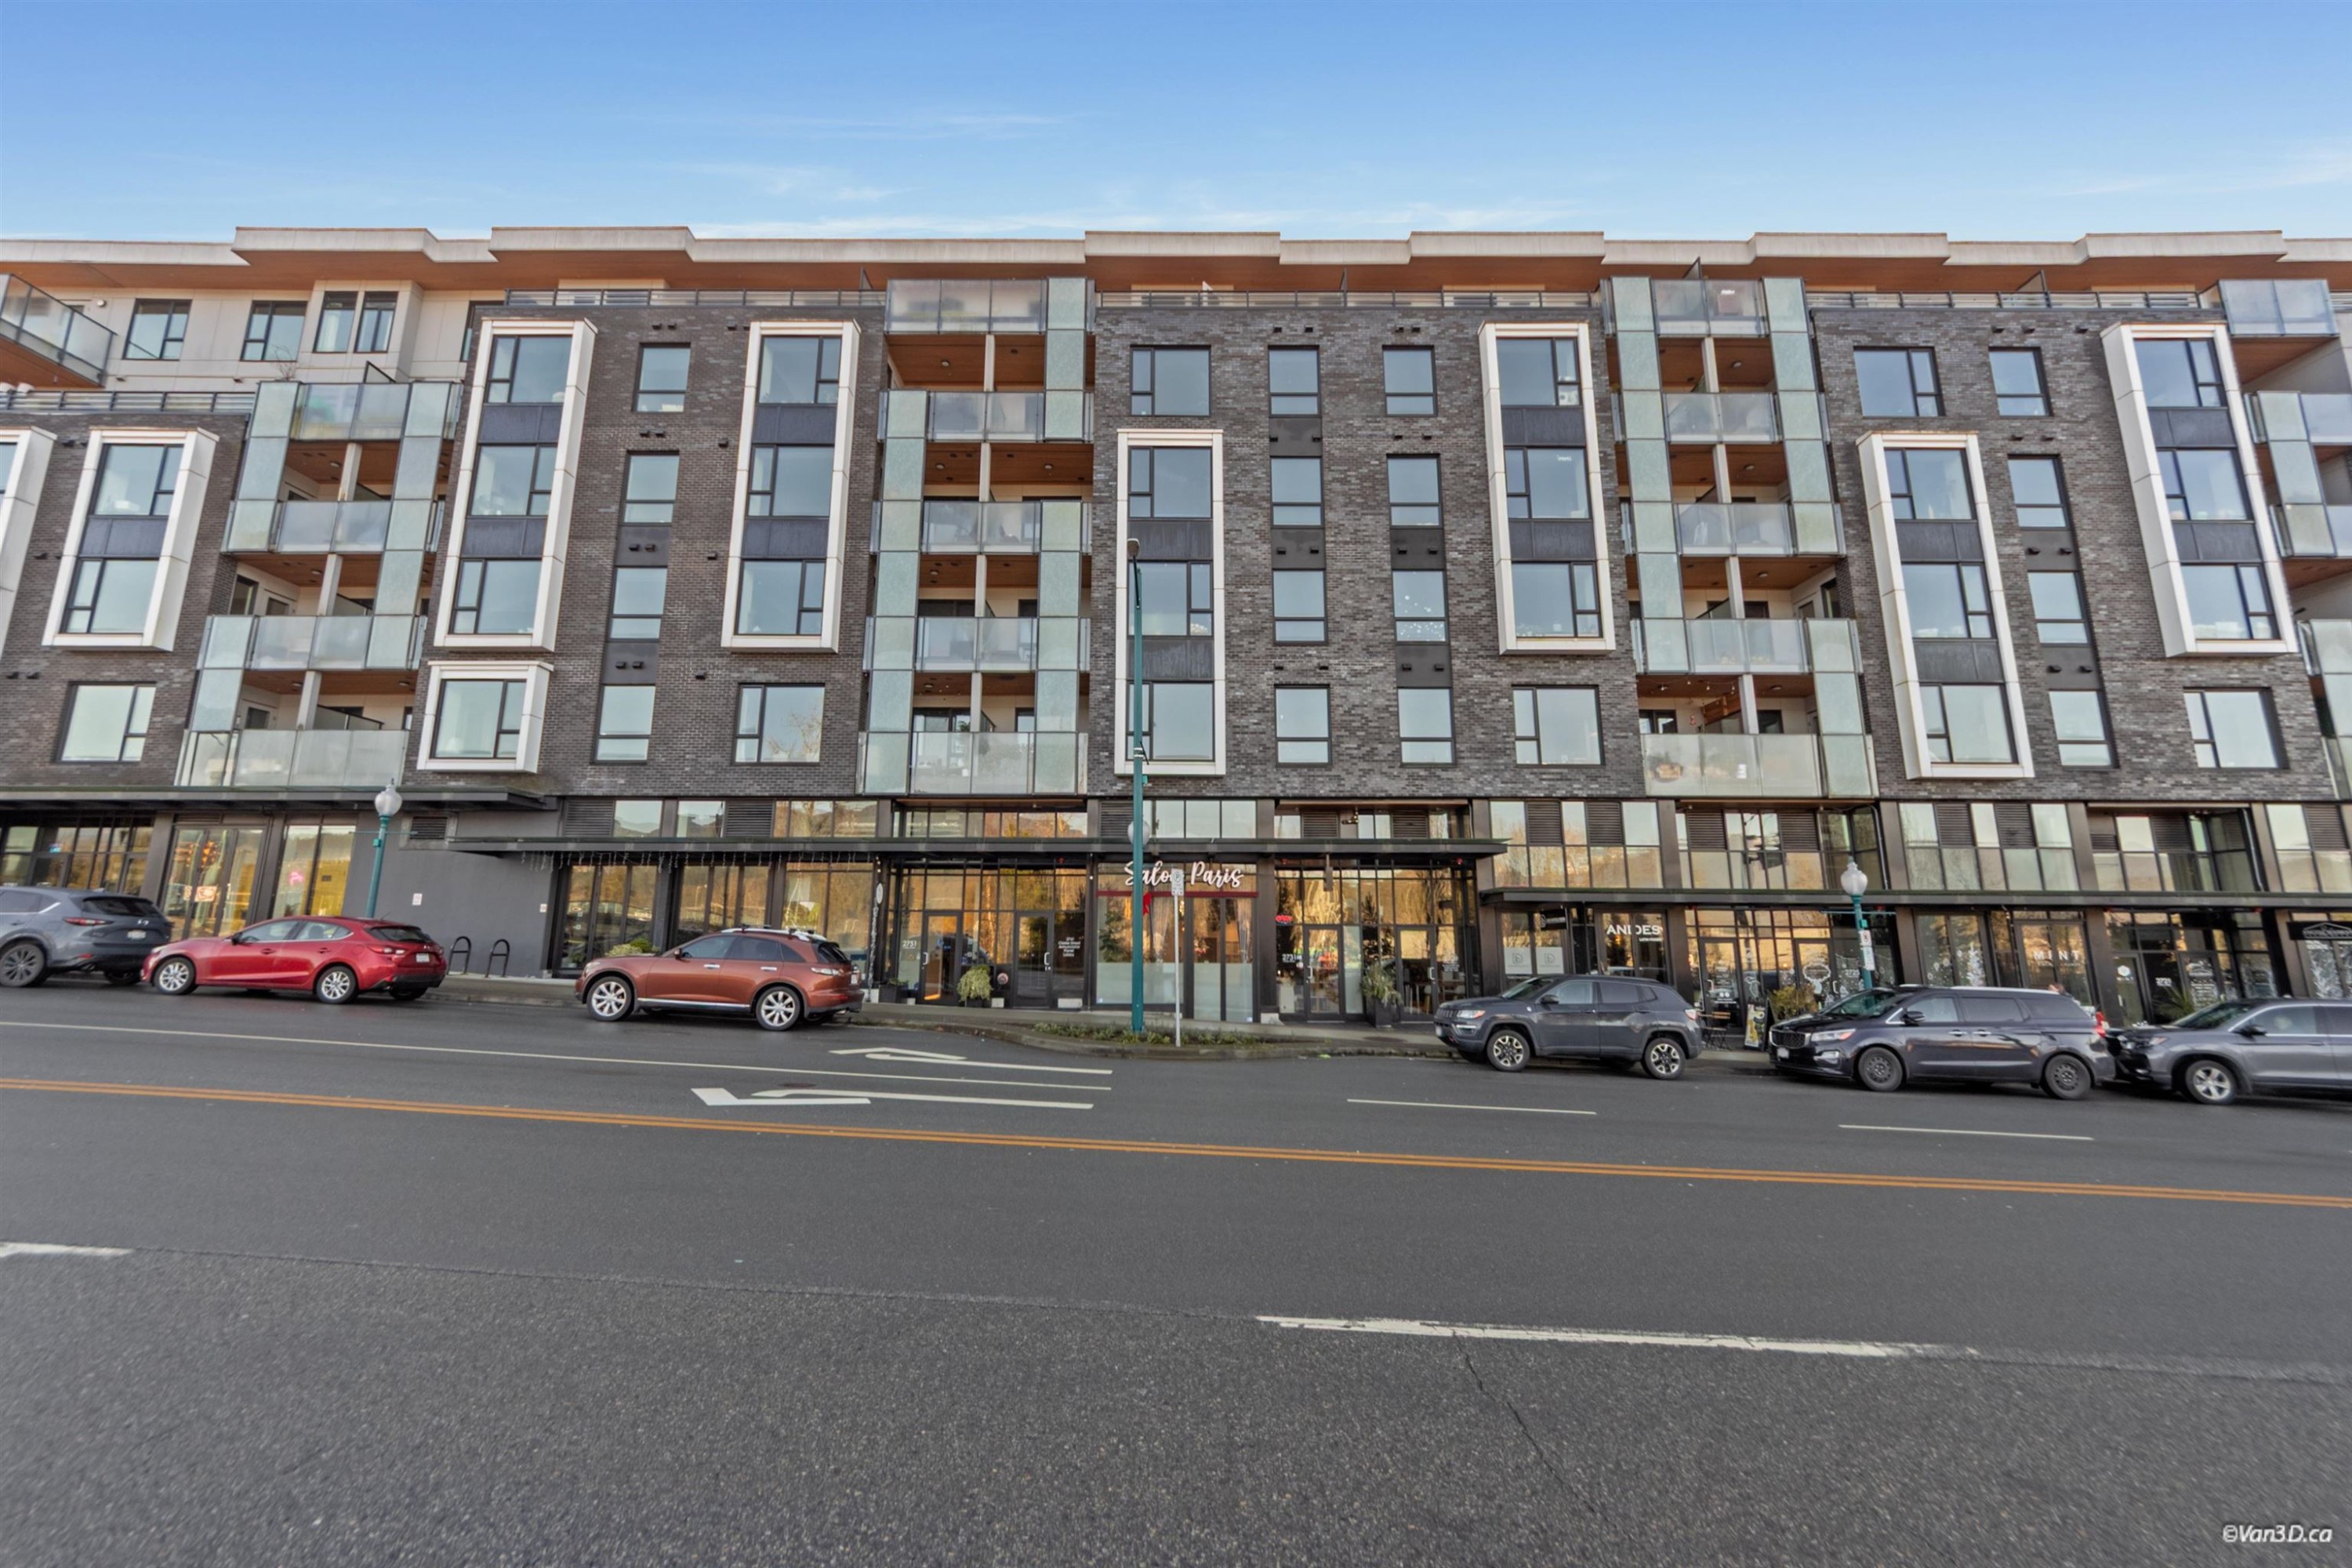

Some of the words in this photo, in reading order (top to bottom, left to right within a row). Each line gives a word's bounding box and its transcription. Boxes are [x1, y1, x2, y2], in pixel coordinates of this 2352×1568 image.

[1123, 860, 1184, 887] Salo
[1190, 860, 1245, 888] Paris
[1606, 924, 1661, 935] ANDES
[2033, 949, 2081, 961] MINT
